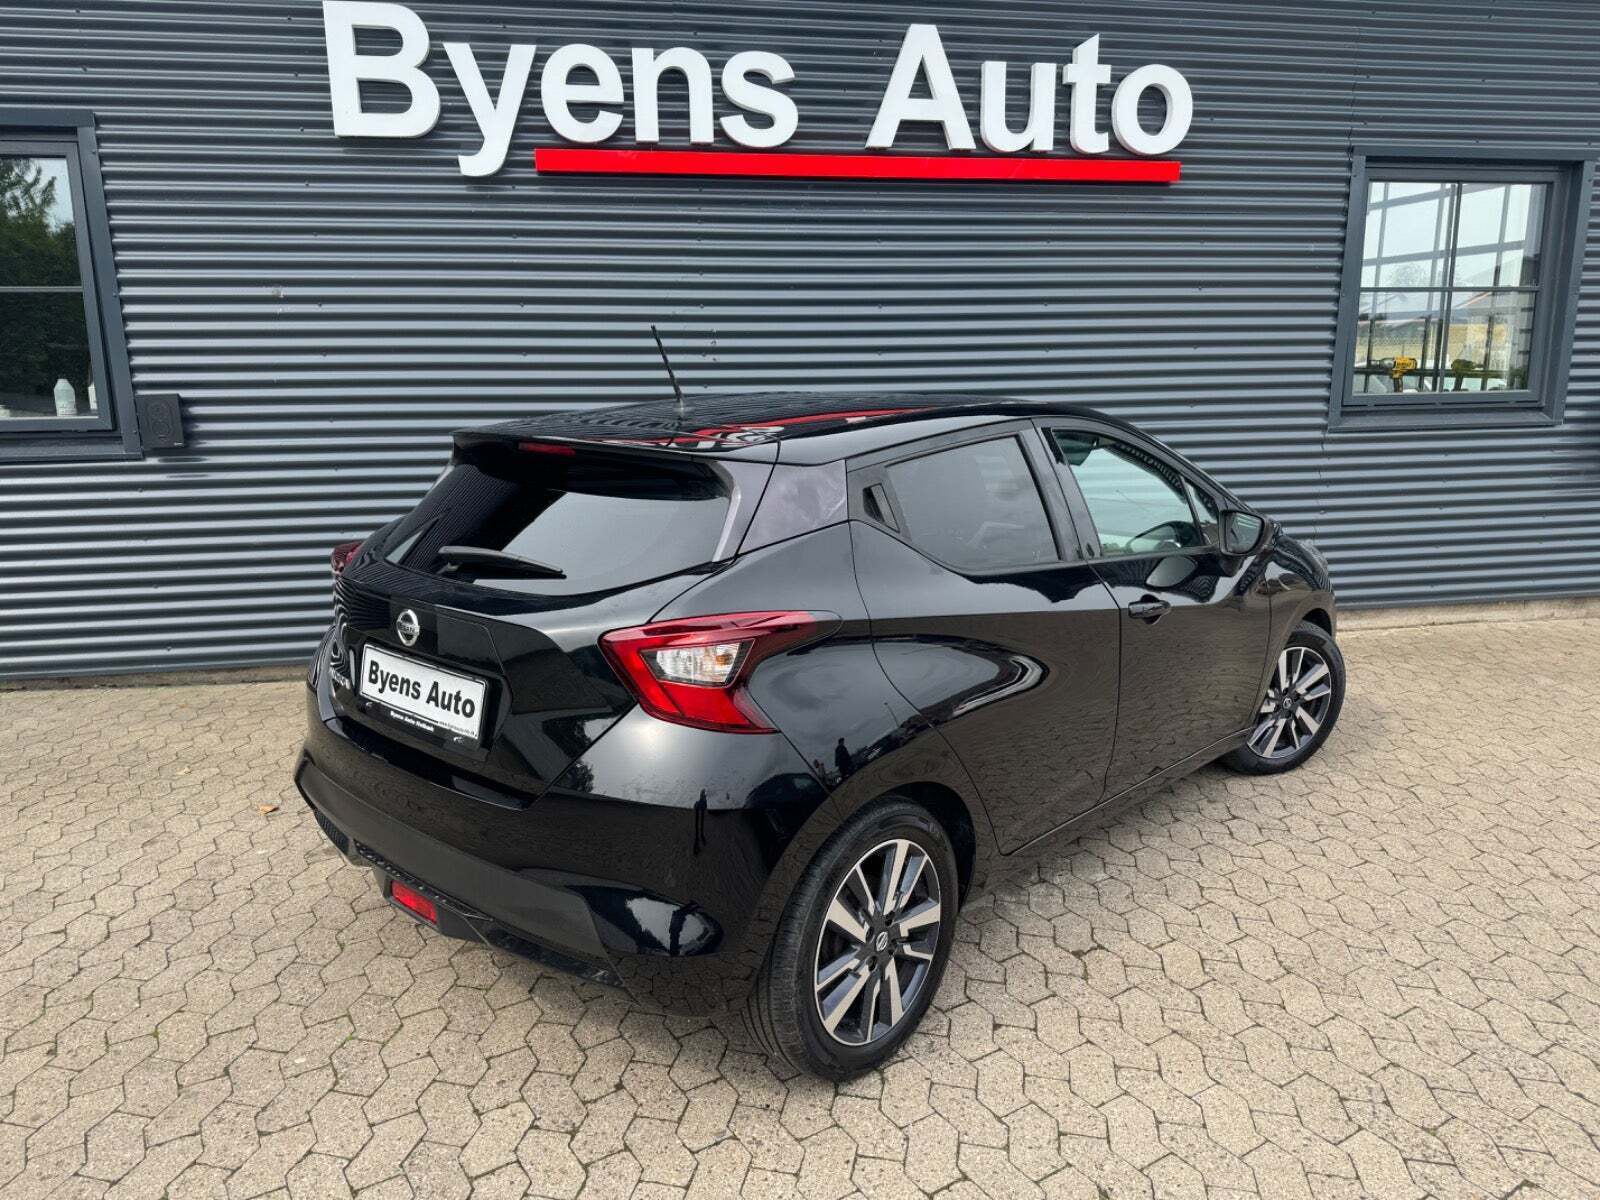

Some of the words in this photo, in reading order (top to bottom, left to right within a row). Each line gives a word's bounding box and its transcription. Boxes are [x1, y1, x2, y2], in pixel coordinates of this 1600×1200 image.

[322, 0, 799, 177] Byens
[866, 24, 1194, 156] Auto
[368, 660, 421, 699] Byens
[425, 681, 476, 718] Auto
